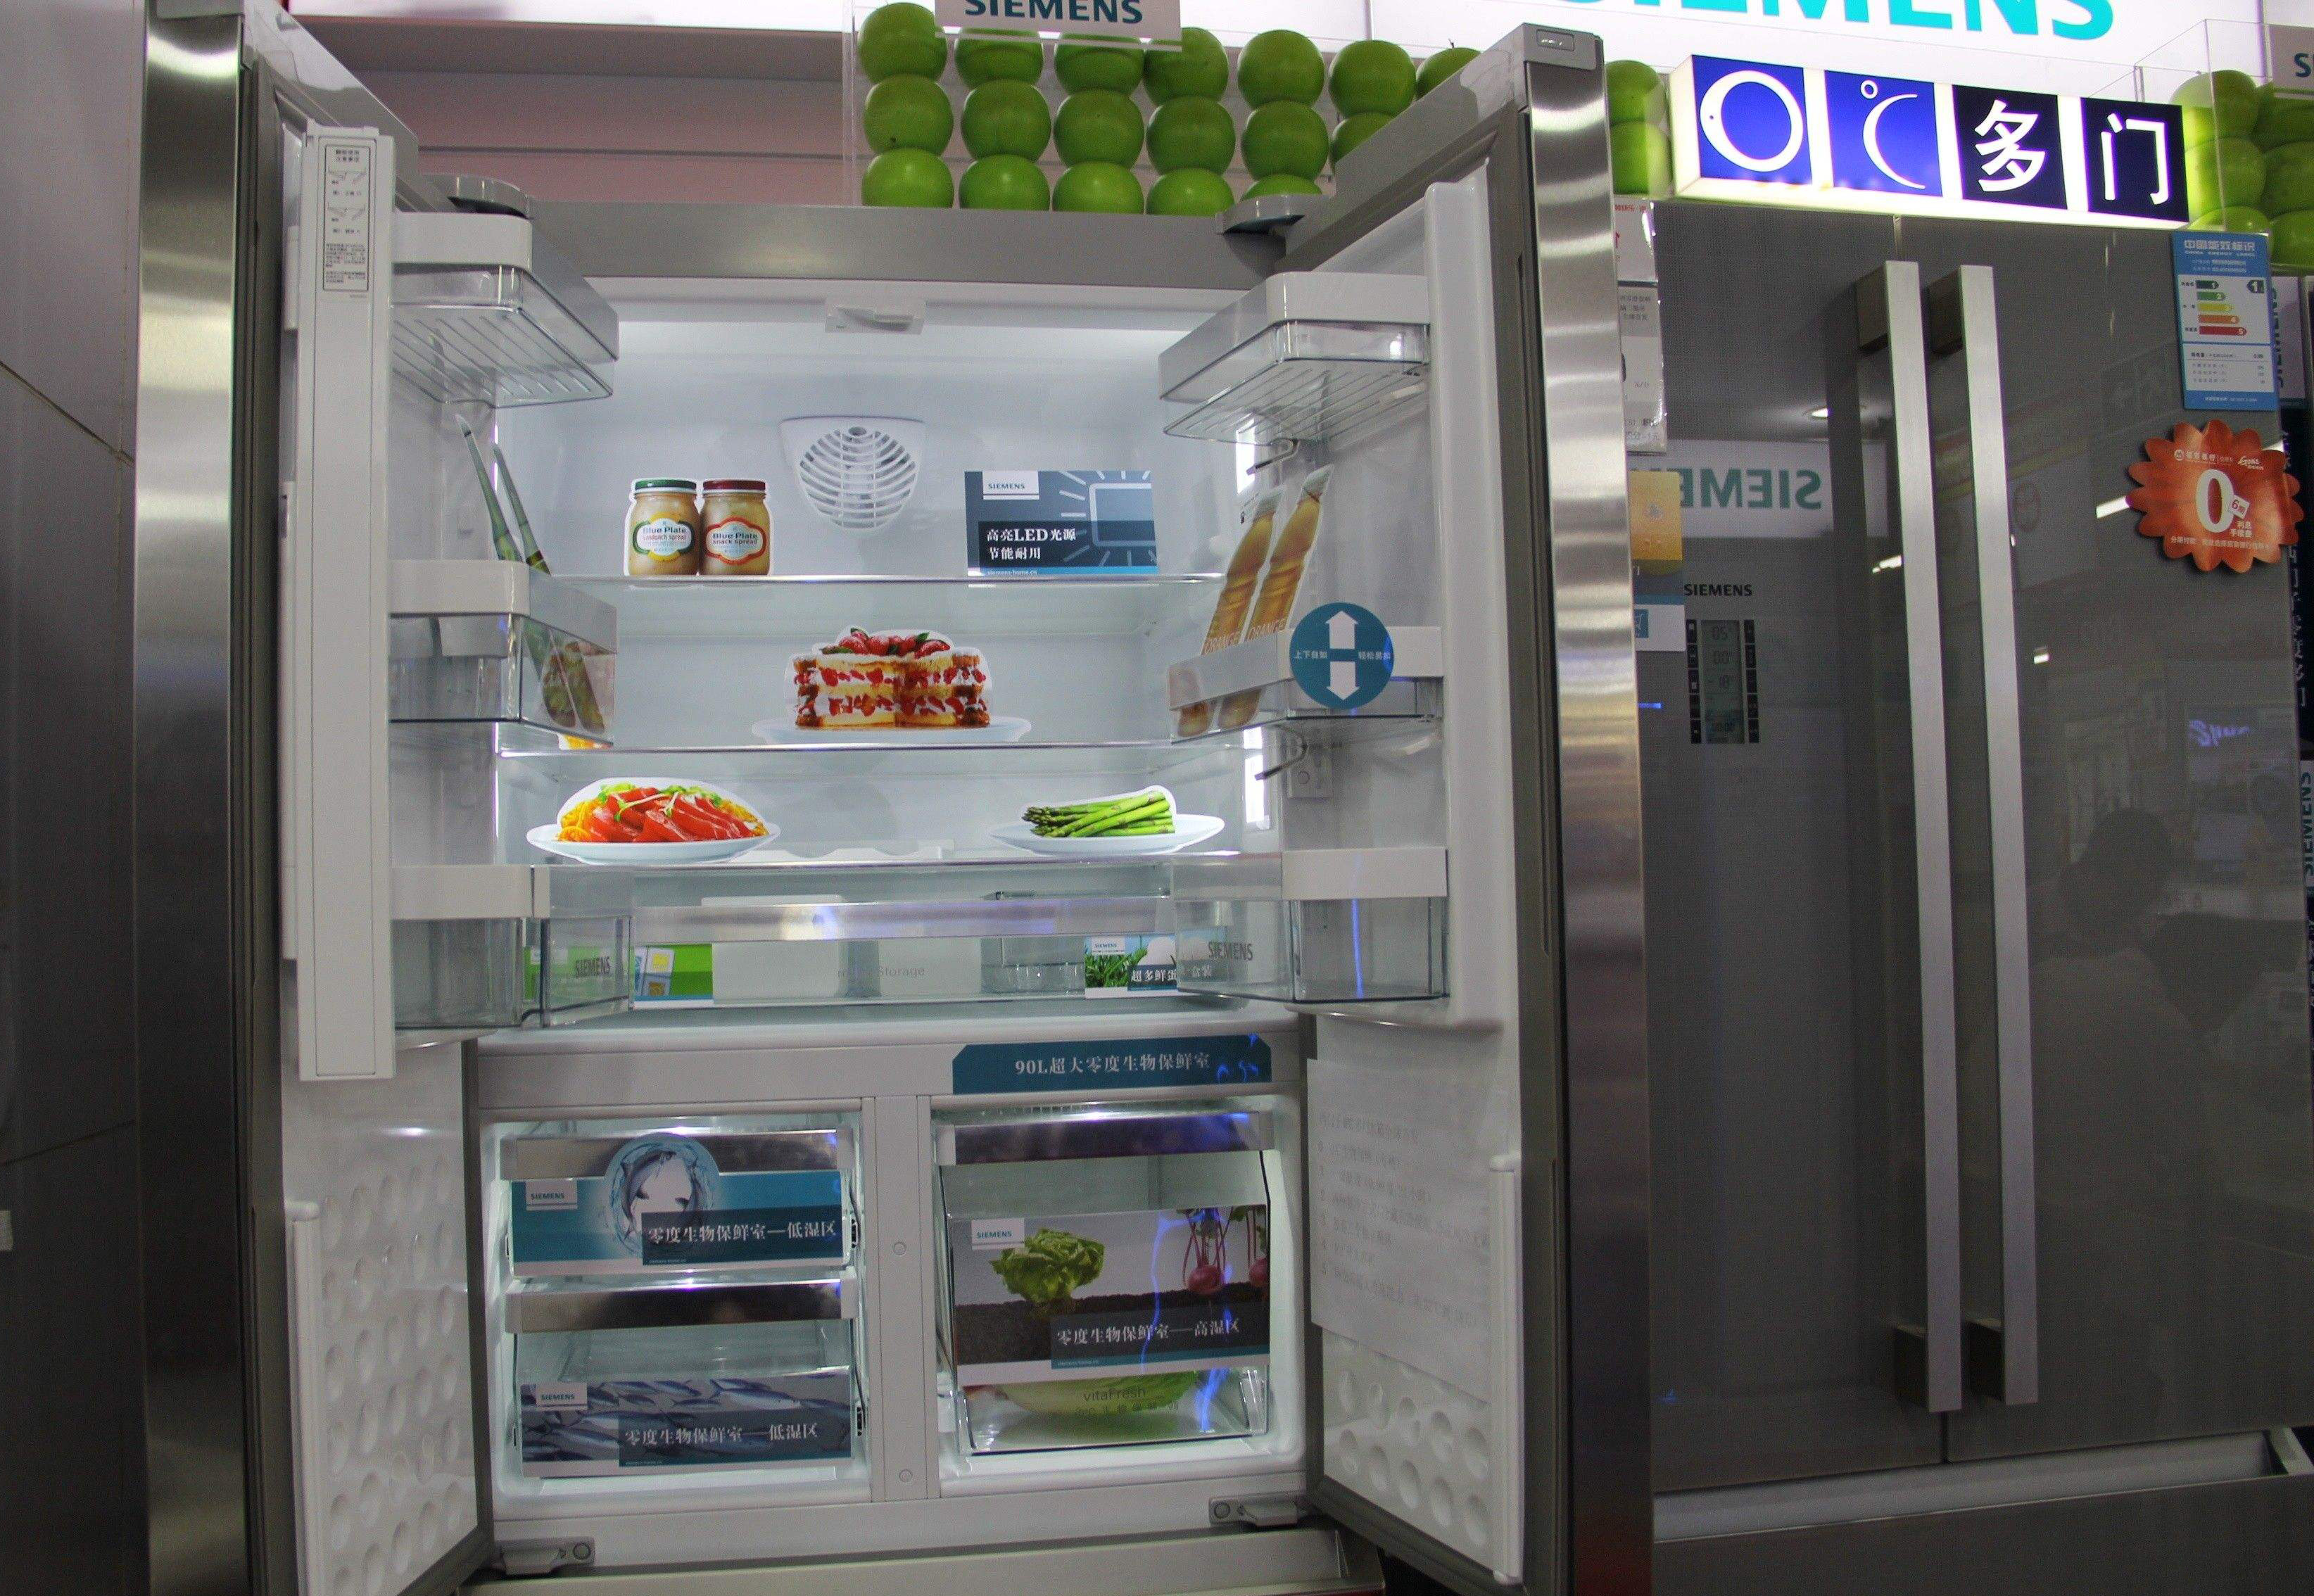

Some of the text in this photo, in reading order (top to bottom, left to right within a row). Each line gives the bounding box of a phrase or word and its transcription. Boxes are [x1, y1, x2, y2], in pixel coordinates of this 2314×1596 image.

[965, 0, 1143, 24] SIEMENS
[2294, 53, 2314, 79] S
[2184, 240, 2256, 251] 中国能效标识
[2196, 469, 2234, 533] 0
[987, 528, 1077, 542] 高亮LED光源
[989, 547, 1041, 560] 节能耐用
[1684, 583, 1752, 597] SIEMENS
[1208, 941, 1253, 961] SIEMENS
[576, 956, 611, 978] SIEMENS
[1015, 1053, 1210, 1075] 90L超大零度生物保鲜室
[531, 1192, 565, 1201] SIEMENS
[541, 1393, 576, 1402] SIEMENS
[1083, 1386, 1146, 1402] vitaFresh
